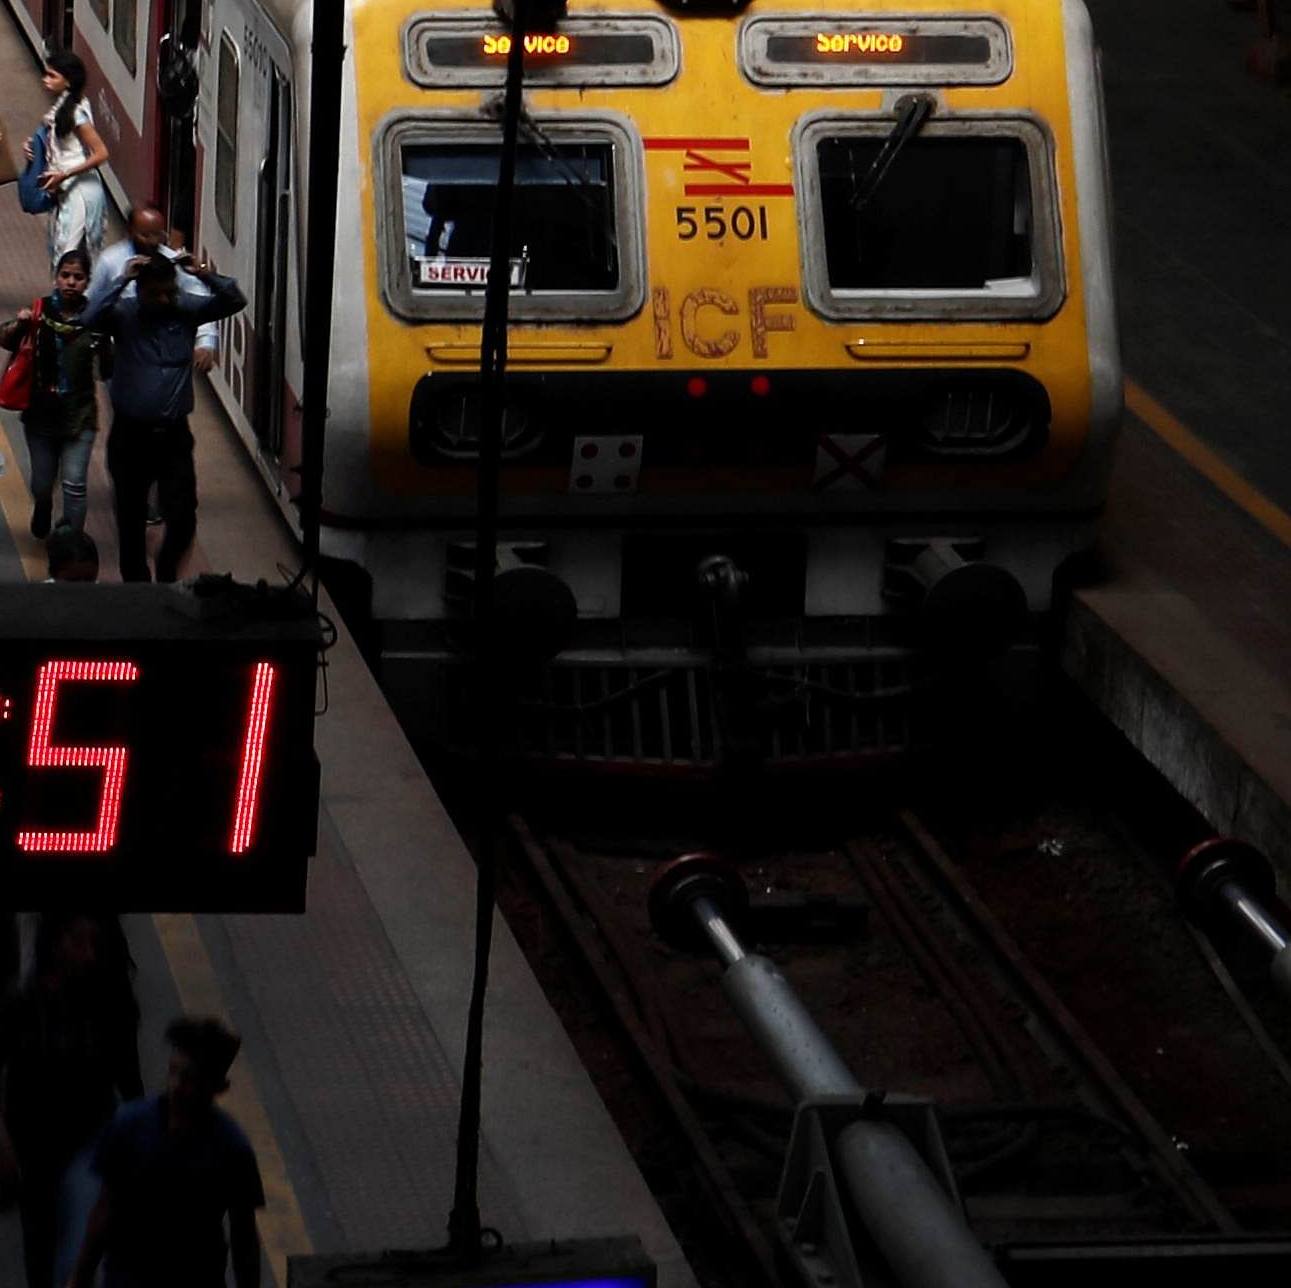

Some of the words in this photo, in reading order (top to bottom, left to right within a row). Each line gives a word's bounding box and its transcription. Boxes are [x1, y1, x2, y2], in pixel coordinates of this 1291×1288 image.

[482, 34, 570, 54] Sevice
[676, 205, 768, 241] 5501
[427, 265, 491, 282] SERVI
[652, 285, 799, 360] ICF
